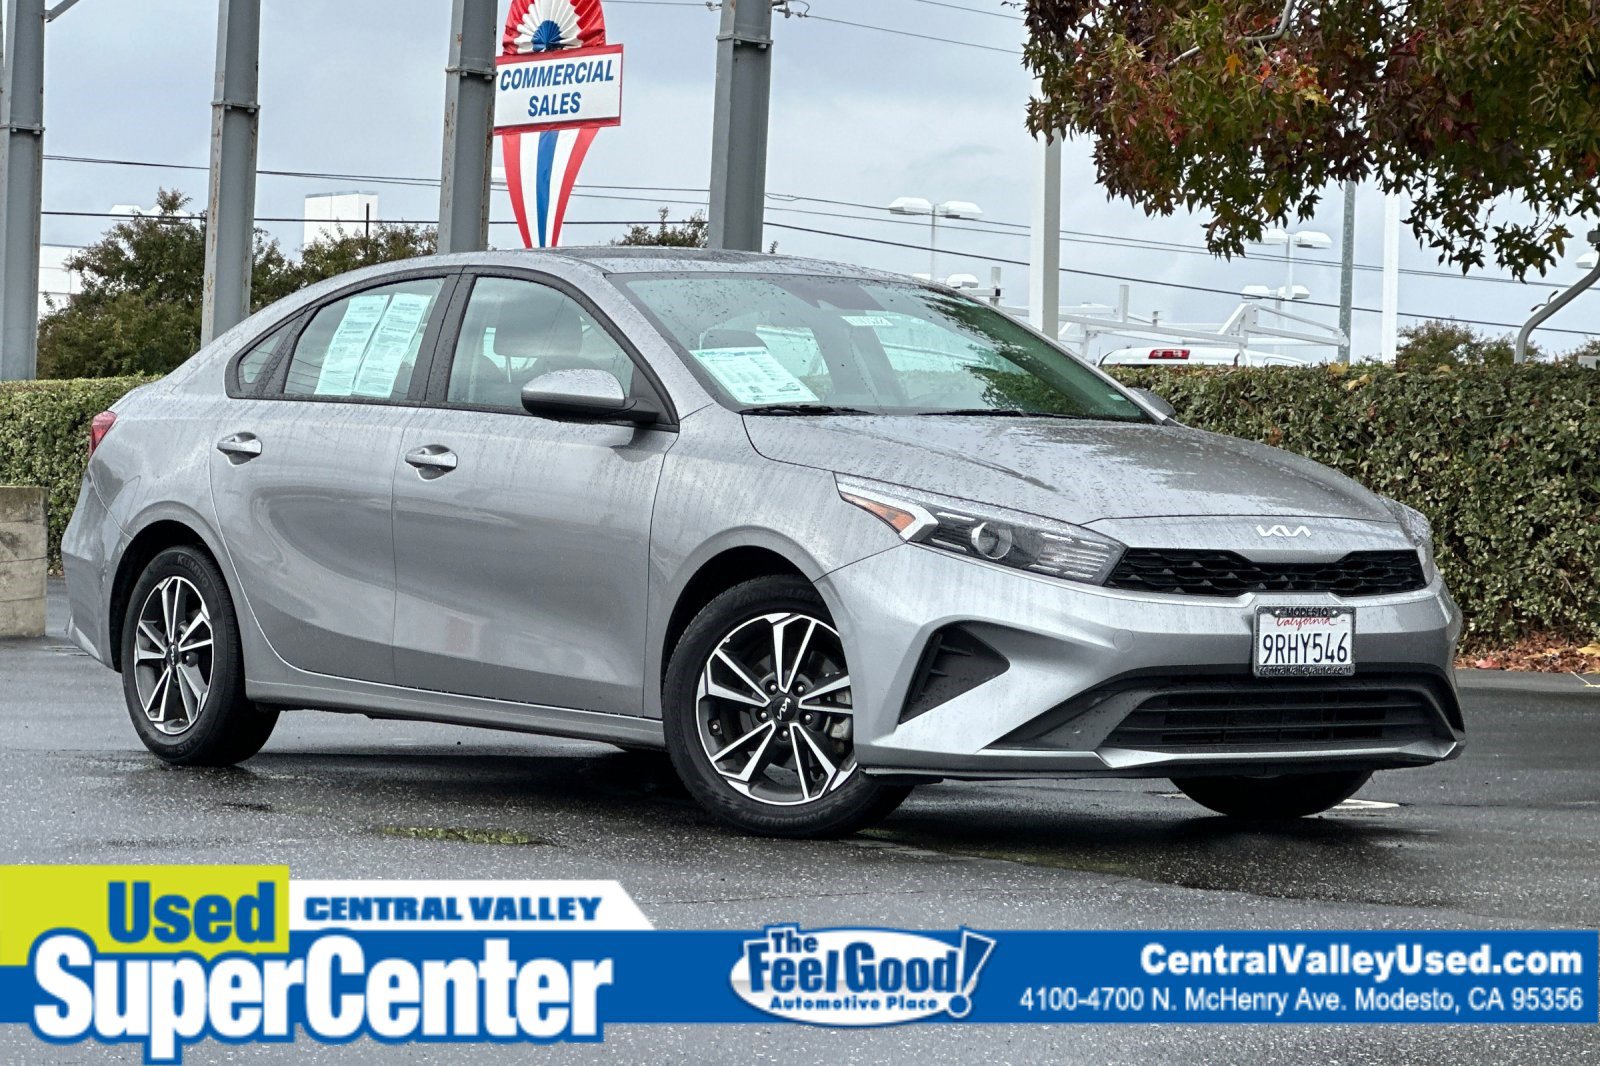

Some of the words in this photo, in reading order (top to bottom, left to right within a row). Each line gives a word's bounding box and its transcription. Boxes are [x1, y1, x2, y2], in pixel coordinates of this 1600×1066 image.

[500, 59, 614, 91] COMMERCIAL
[528, 92, 582, 117] SALES
[1256, 524, 1312, 537] KIA
[1286, 607, 1329, 617] MODESTO
[1276, 617, 1337, 631] California
[1263, 632, 1348, 664] 9RHY546
